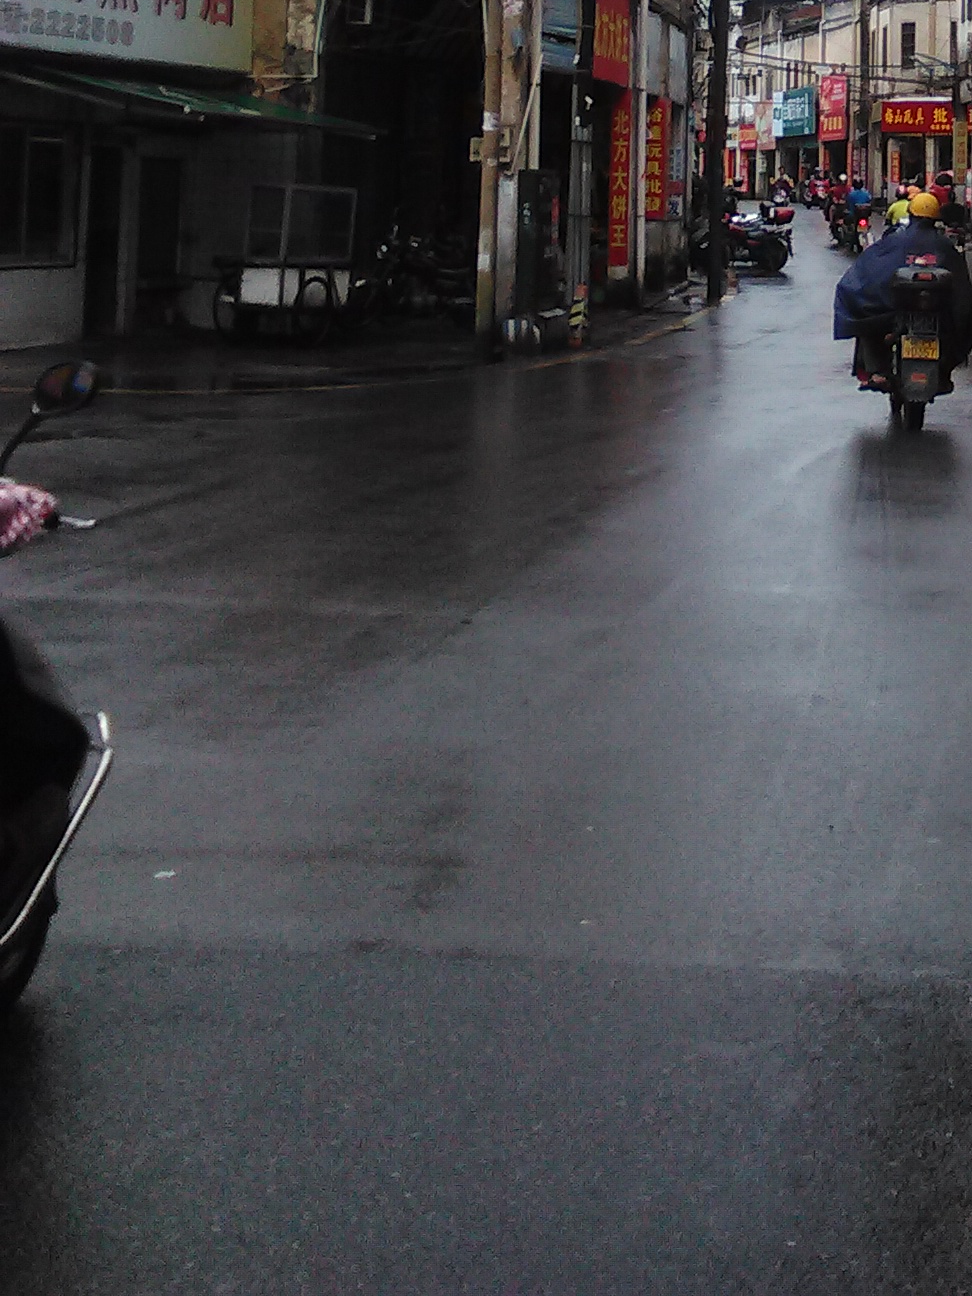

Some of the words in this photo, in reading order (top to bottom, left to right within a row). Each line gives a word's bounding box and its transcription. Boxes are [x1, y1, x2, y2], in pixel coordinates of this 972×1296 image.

[611, 109, 630, 247] 北方大饼王
